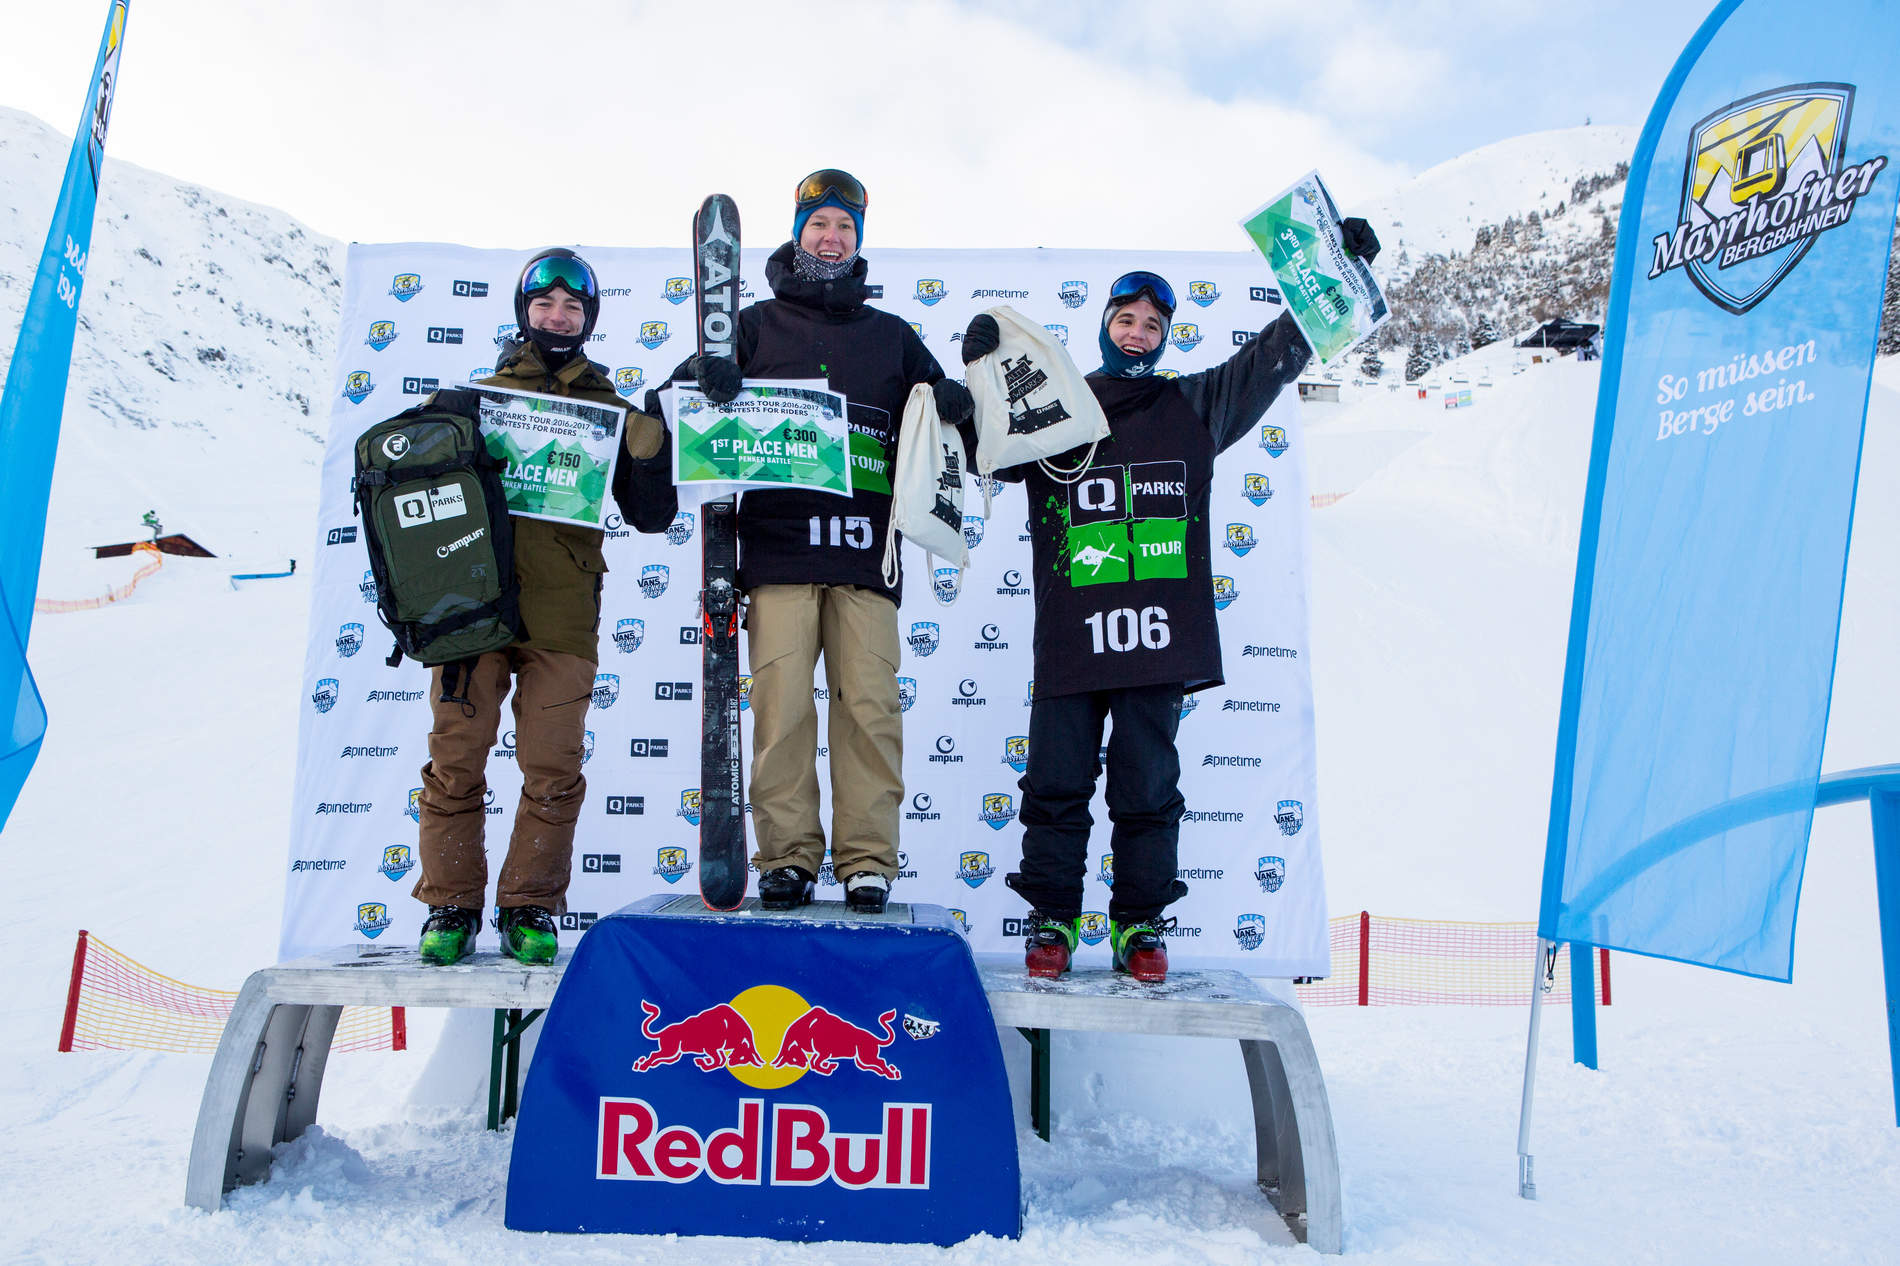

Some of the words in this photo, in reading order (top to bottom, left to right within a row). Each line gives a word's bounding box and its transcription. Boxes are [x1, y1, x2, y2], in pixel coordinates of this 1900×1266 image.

[1650, 156, 1887, 279] Mayrhofner
[1723, 202, 1852, 268] BERGBAHNEN
[1335, 248, 1349, 267] TOUR
[1280, 228, 1300, 249] 3RD
[1291, 249, 1320, 294] PLACE
[1316, 290, 1340, 325] MEN
[1331, 258, 1343, 273] FOR
[1340, 270, 1360, 296] RIDERS
[981, 288, 1029, 299] pinetime
[1657, 374, 1688, 404] So
[1697, 340, 1817, 392] müssen
[718, 407, 760, 415] CONTESTS
[781, 409, 809, 417] RIDERS
[1656, 399, 1734, 440] Berge
[1743, 379, 1816, 416] sein.
[490, 418, 531, 430] CONTESTS
[533, 424, 548, 433] FOR
[550, 427, 577, 437] RIDERS
[529, 415, 552, 426] TOUR
[783, 428, 817, 443] €300
[710, 438, 729, 454] 1ST
[733, 439, 781, 457] PLACE
[785, 442, 818, 459] MEN
[767, 457, 791, 465] BATTLE
[850, 455, 886, 475] TOUR
[504, 461, 543, 483] LACE
[545, 467, 578, 488] MEN
[1077, 478, 1116, 512] Q
[1132, 480, 1184, 496] PARKS
[402, 498, 426, 519] Q
[432, 494, 463, 508] PARKS
[809, 516, 873, 549] 115
[1140, 541, 1182, 557] TOUR
[359, 581, 376, 592] VAN
[1085, 606, 1171, 654] 106
[907, 634, 931, 645] VANS
[1252, 646, 1297, 658] pinetime
[377, 690, 424, 702] pinetime
[593, 686, 610, 697] ANS
[1233, 700, 1281, 712] pinetime
[351, 746, 398, 758] pinetime
[1213, 755, 1262, 767] pinetime
[731, 760, 739, 805] ATOMIC
[326, 802, 372, 815] pinetime
[1193, 810, 1244, 823] pinetime
[1273, 812, 1295, 824] VANS
[300, 859, 346, 872] pinetime
[1254, 869, 1277, 881] VANS
[1233, 926, 1257, 938] VANS
[597, 1096, 764, 1185] Red
[770, 1102, 932, 1190] Bull
